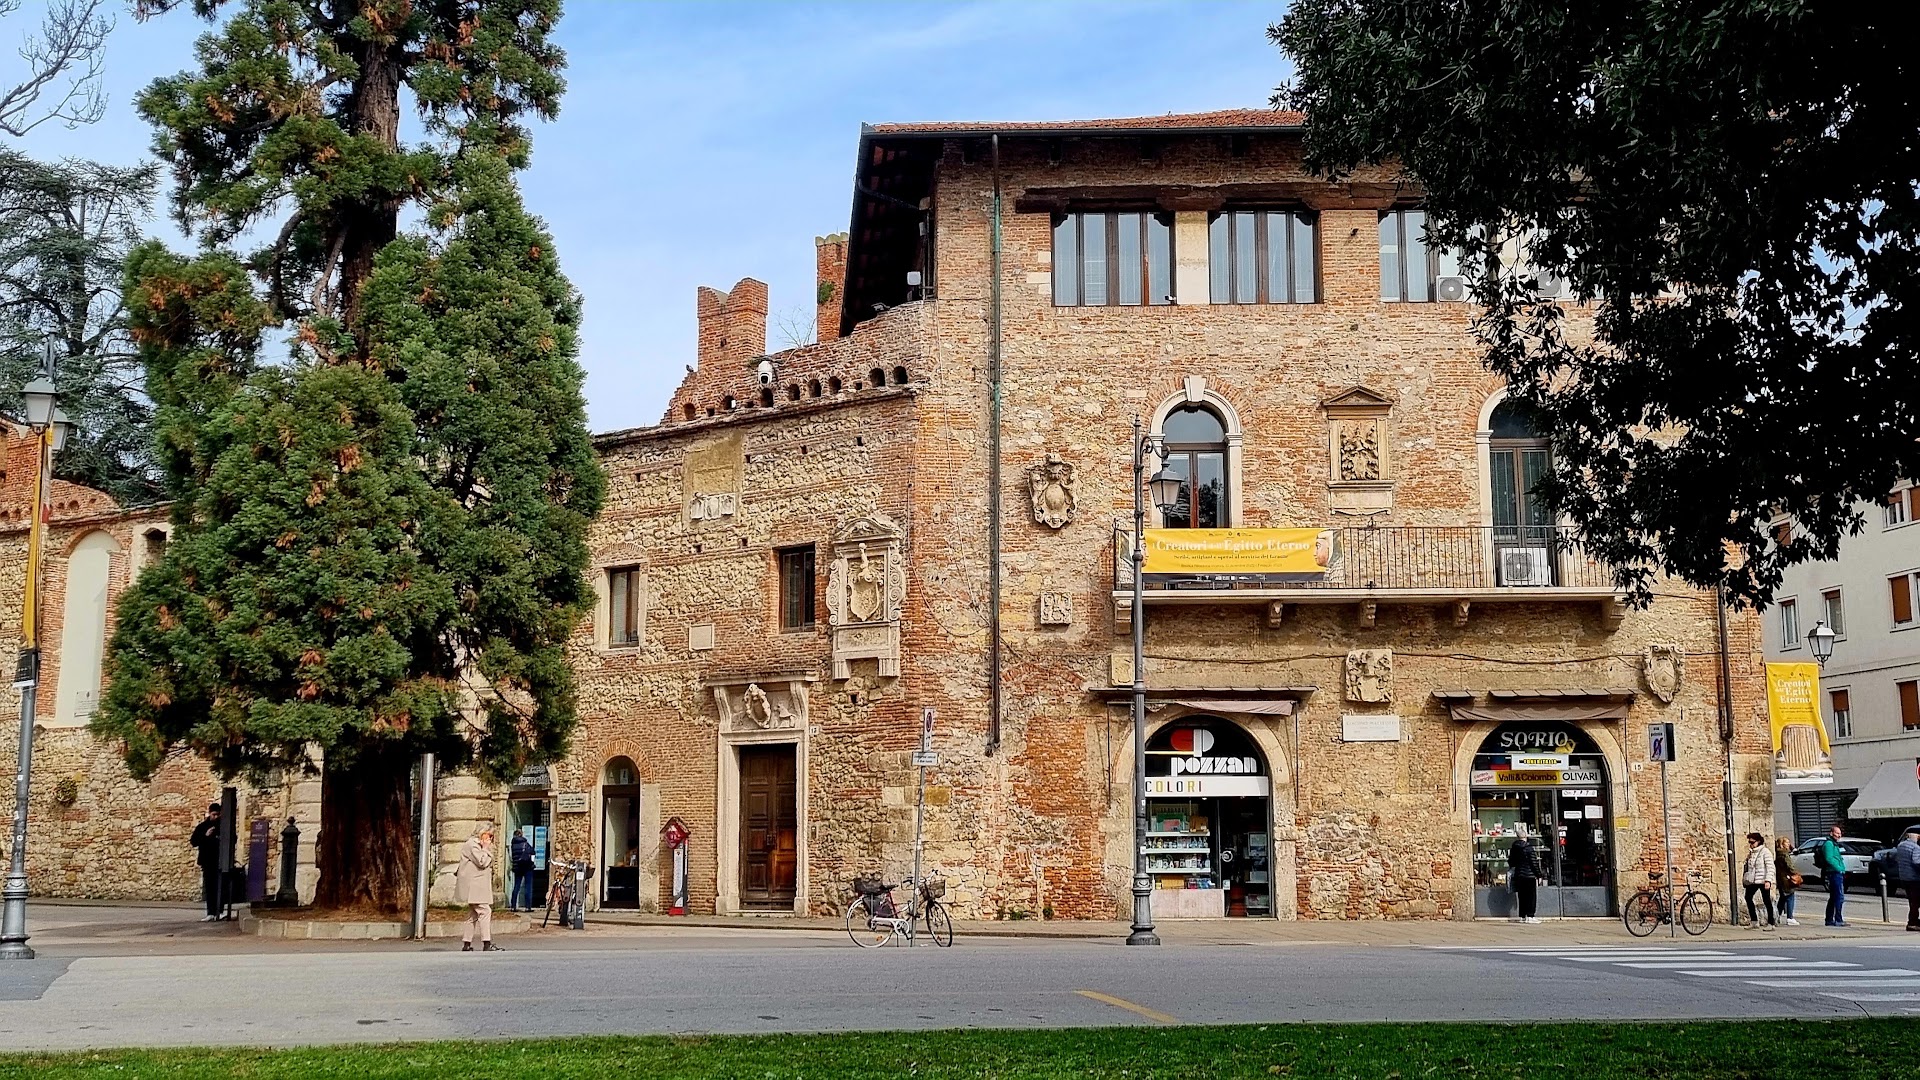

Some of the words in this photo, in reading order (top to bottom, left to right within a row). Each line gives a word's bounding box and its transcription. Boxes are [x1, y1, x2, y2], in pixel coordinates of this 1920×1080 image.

[1156, 540, 1207, 551] Creatori
[1267, 540, 1311, 551] Eterno
[1780, 695, 1811, 704] Eterno
[1500, 731, 1568, 750] SORIO
[1170, 757, 1257, 776] pozzan
[1498, 773, 1558, 782] Valli&Colombo
[1562, 772, 1598, 781] OLIVARI
[1145, 781, 1202, 793] COLORI
